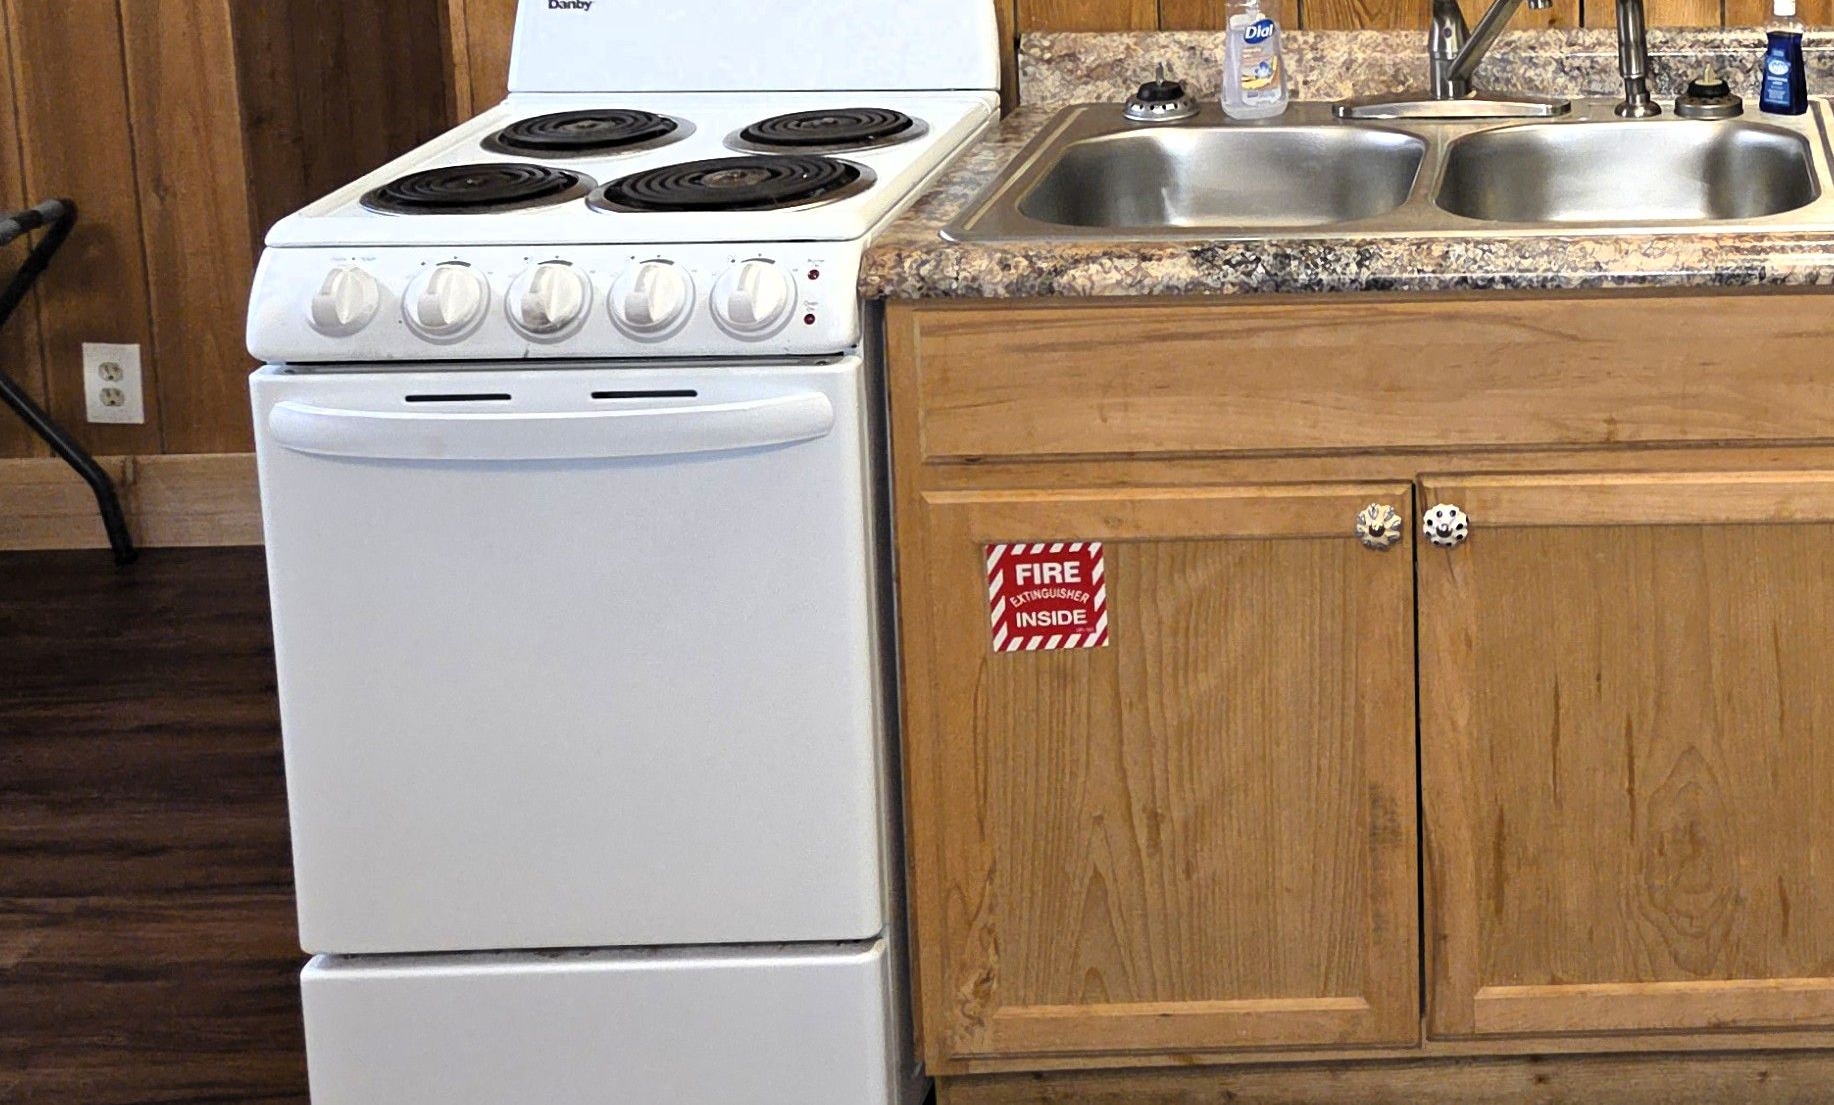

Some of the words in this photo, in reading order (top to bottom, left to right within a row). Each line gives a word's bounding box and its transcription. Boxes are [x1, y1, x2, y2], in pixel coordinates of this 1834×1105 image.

[1244, 23, 1274, 40] Dial
[1015, 561, 1082, 586] FIRE
[1009, 587, 1091, 608] EXTINGUISHER
[1015, 609, 1088, 628] INSIDE
